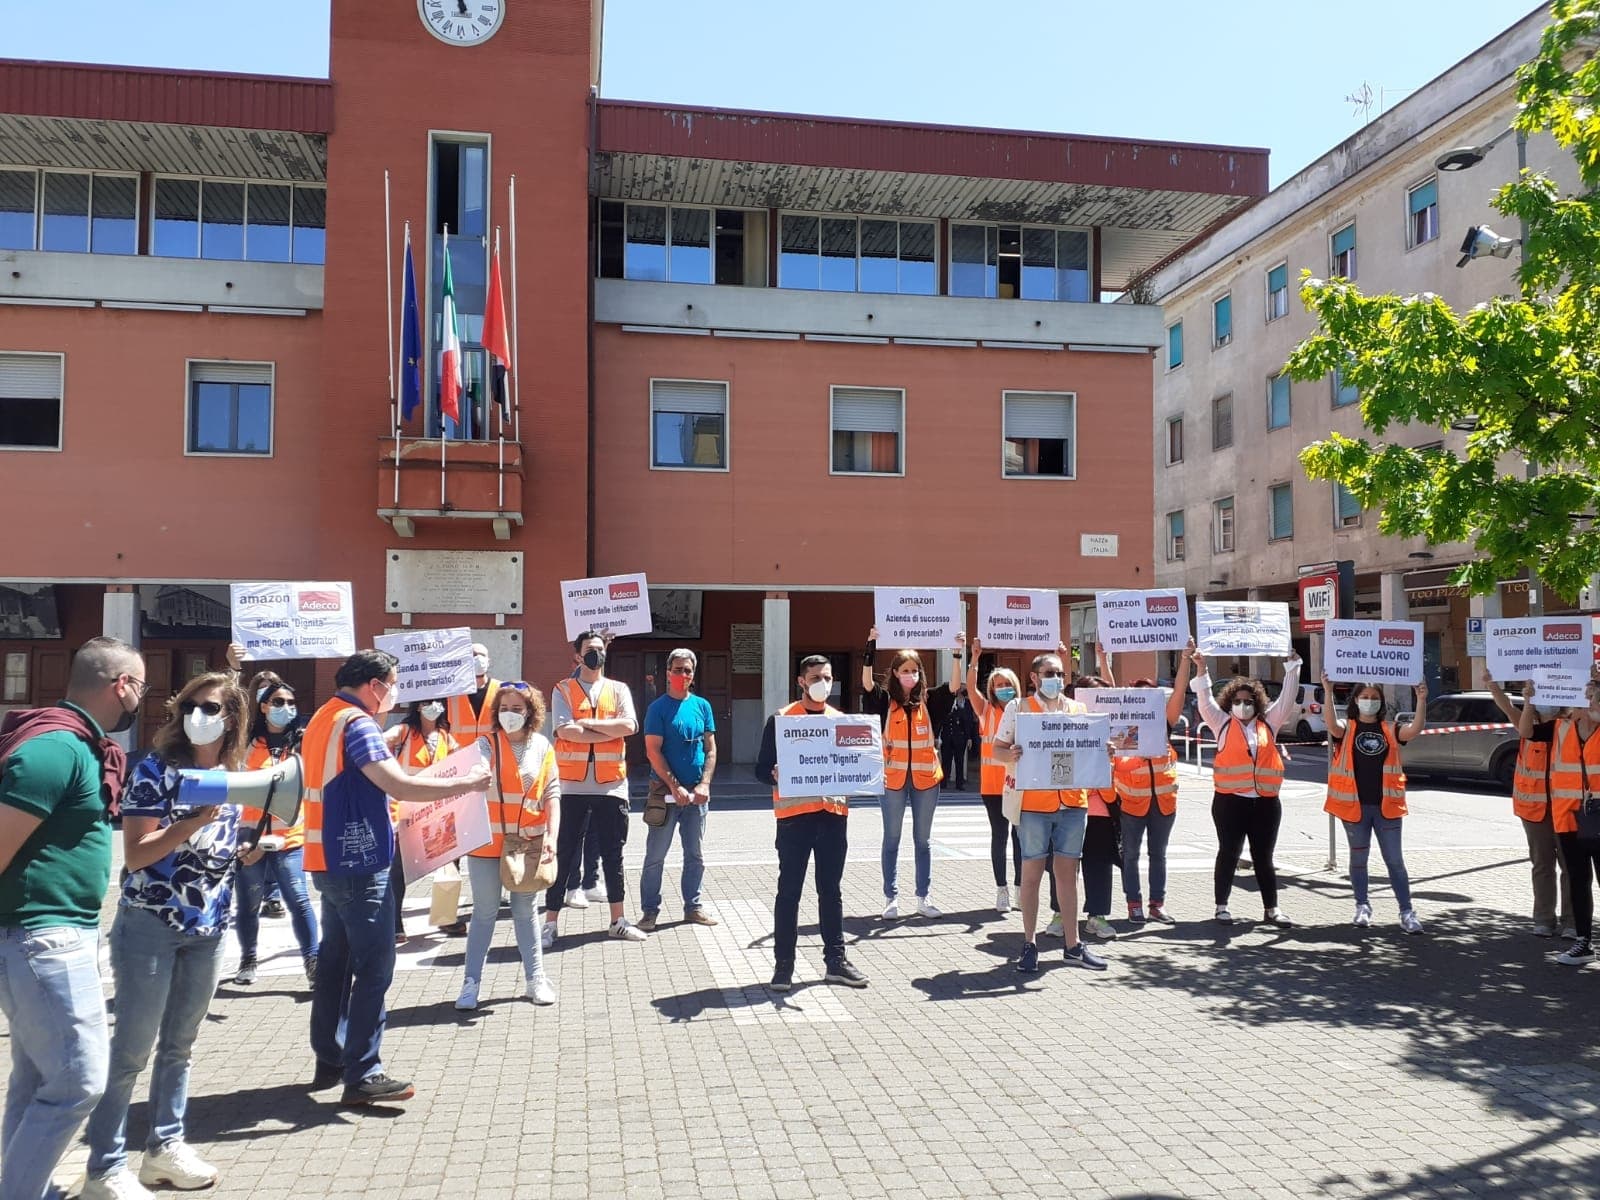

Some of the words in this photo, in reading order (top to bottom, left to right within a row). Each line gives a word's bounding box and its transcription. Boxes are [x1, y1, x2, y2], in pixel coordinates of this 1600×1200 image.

[568, 587, 604, 598] amazon
[612, 591, 638, 599] Adecco
[240, 594, 290, 605] amazon
[302, 600, 339, 610] Adecco
[899, 596, 935, 605] amazon
[1308, 590, 1330, 608] WiFi
[597, 606, 611, 614] delle
[611, 602, 639, 613] istituzioni
[1102, 599, 1140, 609] amazon
[1149, 604, 1177, 612] Adecco
[256, 619, 289, 629] Decreto
[609, 619, 627, 628] mostri
[885, 614, 911, 623] Azienda
[912, 614, 919, 623] di
[920, 615, 950, 623] successo
[988, 616, 1013, 626] Agenzia
[1014, 617, 1024, 627] per
[1025, 616, 1030, 625] il
[1031, 616, 1049, 626] lavoro
[1108, 619, 1138, 629] Create
[1140, 617, 1177, 627] LAVORO
[1471, 621, 1480, 632] P
[1492, 626, 1537, 636] amazon
[899, 628, 905, 637] di
[906, 628, 943, 639] precariato?
[993, 632, 1013, 640] contro
[1018, 631, 1050, 642] lavoratori?
[1111, 637, 1127, 645] non
[1129, 633, 1178, 644] ILLUSIONI!
[1331, 628, 1372, 637] amazon
[1381, 636, 1412, 645] Adecco
[246, 639, 260, 648] ma
[262, 638, 278, 647] non
[279, 637, 293, 649] per
[300, 635, 339, 646] lavoratori
[404, 640, 445, 652] amazon
[1335, 649, 1368, 658] Create
[1370, 650, 1410, 660] LAVORO
[1503, 648, 1524, 656] sonno
[1525, 647, 1542, 655] delle
[1544, 646, 1579, 655] istituzioni
[420, 662, 428, 670] di
[429, 660, 462, 670] successo
[1336, 666, 1353, 674] non
[1356, 665, 1409, 677] ILLUSIONI!
[407, 680, 414, 689] di
[415, 675, 456, 689] precariato?
[1095, 695, 1122, 706] Amazon,
[1123, 695, 1146, 704] Adecco
[1120, 711, 1129, 720] dei
[1130, 711, 1156, 720] miracoli
[1041, 721, 1061, 731] Siamo
[1062, 722, 1089, 732] persone
[784, 728, 829, 738] amazon
[839, 736, 871, 745] Adecco
[1028, 740, 1041, 748] non
[1043, 738, 1064, 750] pacchi
[1065, 739, 1074, 748] da
[1076, 738, 1101, 748] buttare!
[799, 754, 828, 765] Decreto
[791, 775, 803, 784] ma
[805, 775, 818, 784] non
[820, 775, 832, 785] per
[838, 772, 871, 783] lavoratori
